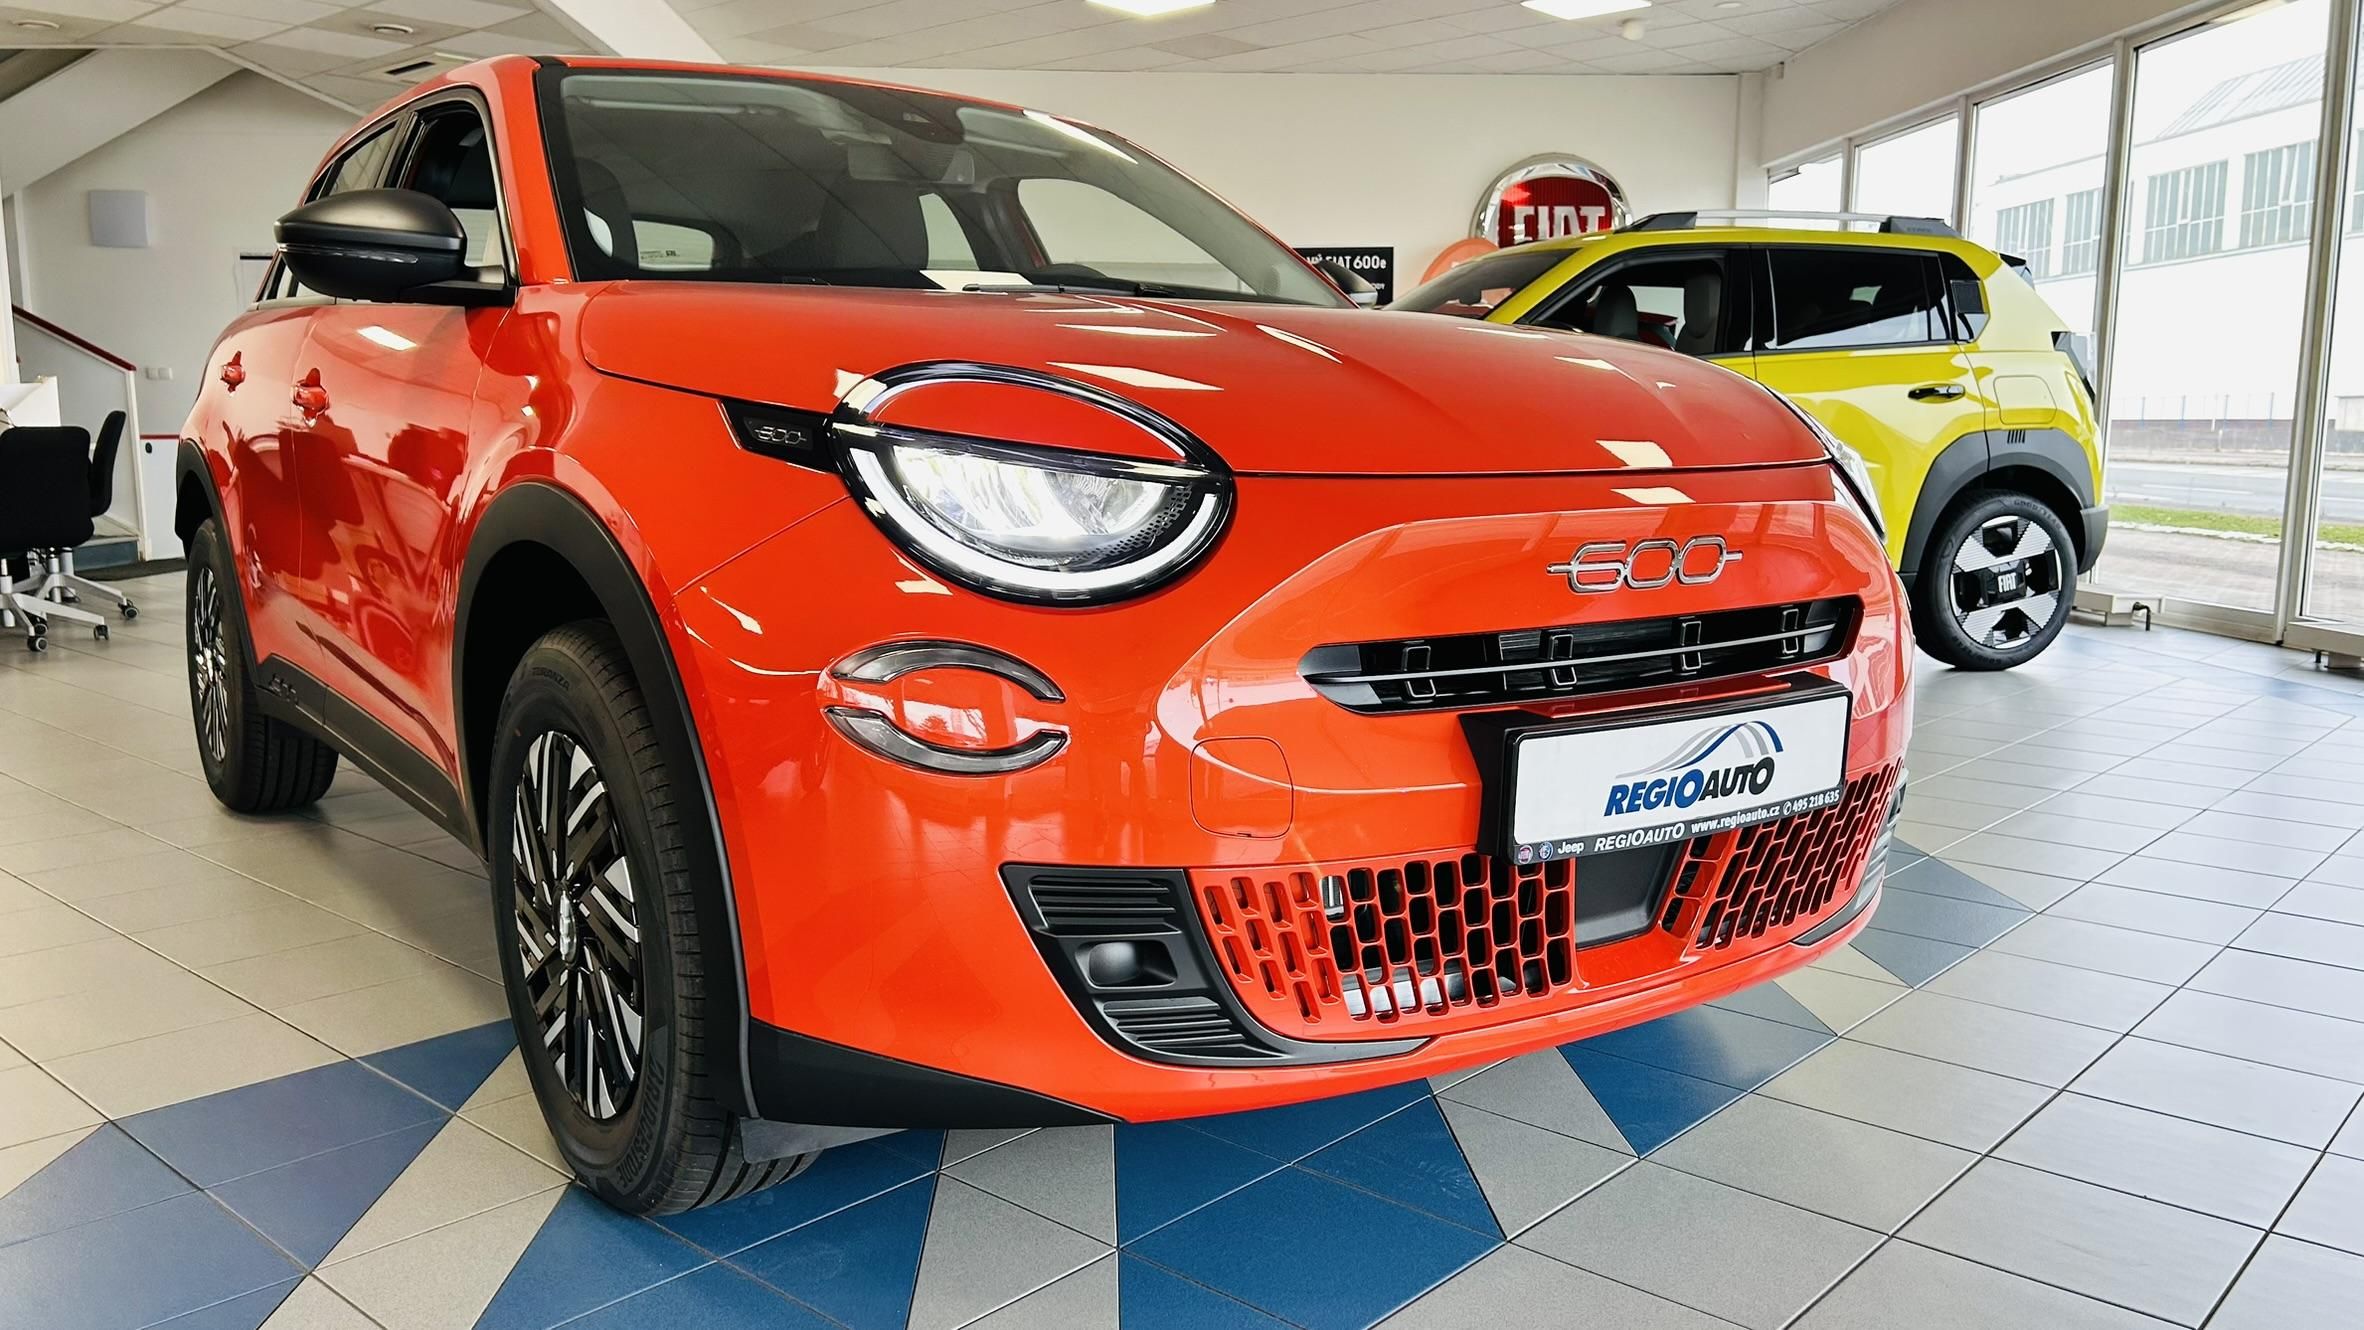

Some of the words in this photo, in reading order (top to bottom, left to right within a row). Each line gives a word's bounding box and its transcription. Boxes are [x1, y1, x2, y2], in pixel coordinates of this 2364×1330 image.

[1513, 206, 1605, 244] FIAT
[1353, 255, 1387, 269] 600e
[1548, 536, 1742, 593] 600
[1997, 572, 2017, 593] FIAT
[1603, 756, 1775, 816] REGIOAUTO
[1557, 841, 1584, 854] Jeep
[1594, 822, 1684, 852] REGIOAUTO
[1691, 805, 1780, 834] www.regioauto.cz
[1793, 799, 1808, 813] 495
[1809, 794, 1824, 808] 218
[1825, 789, 1840, 803] 635
